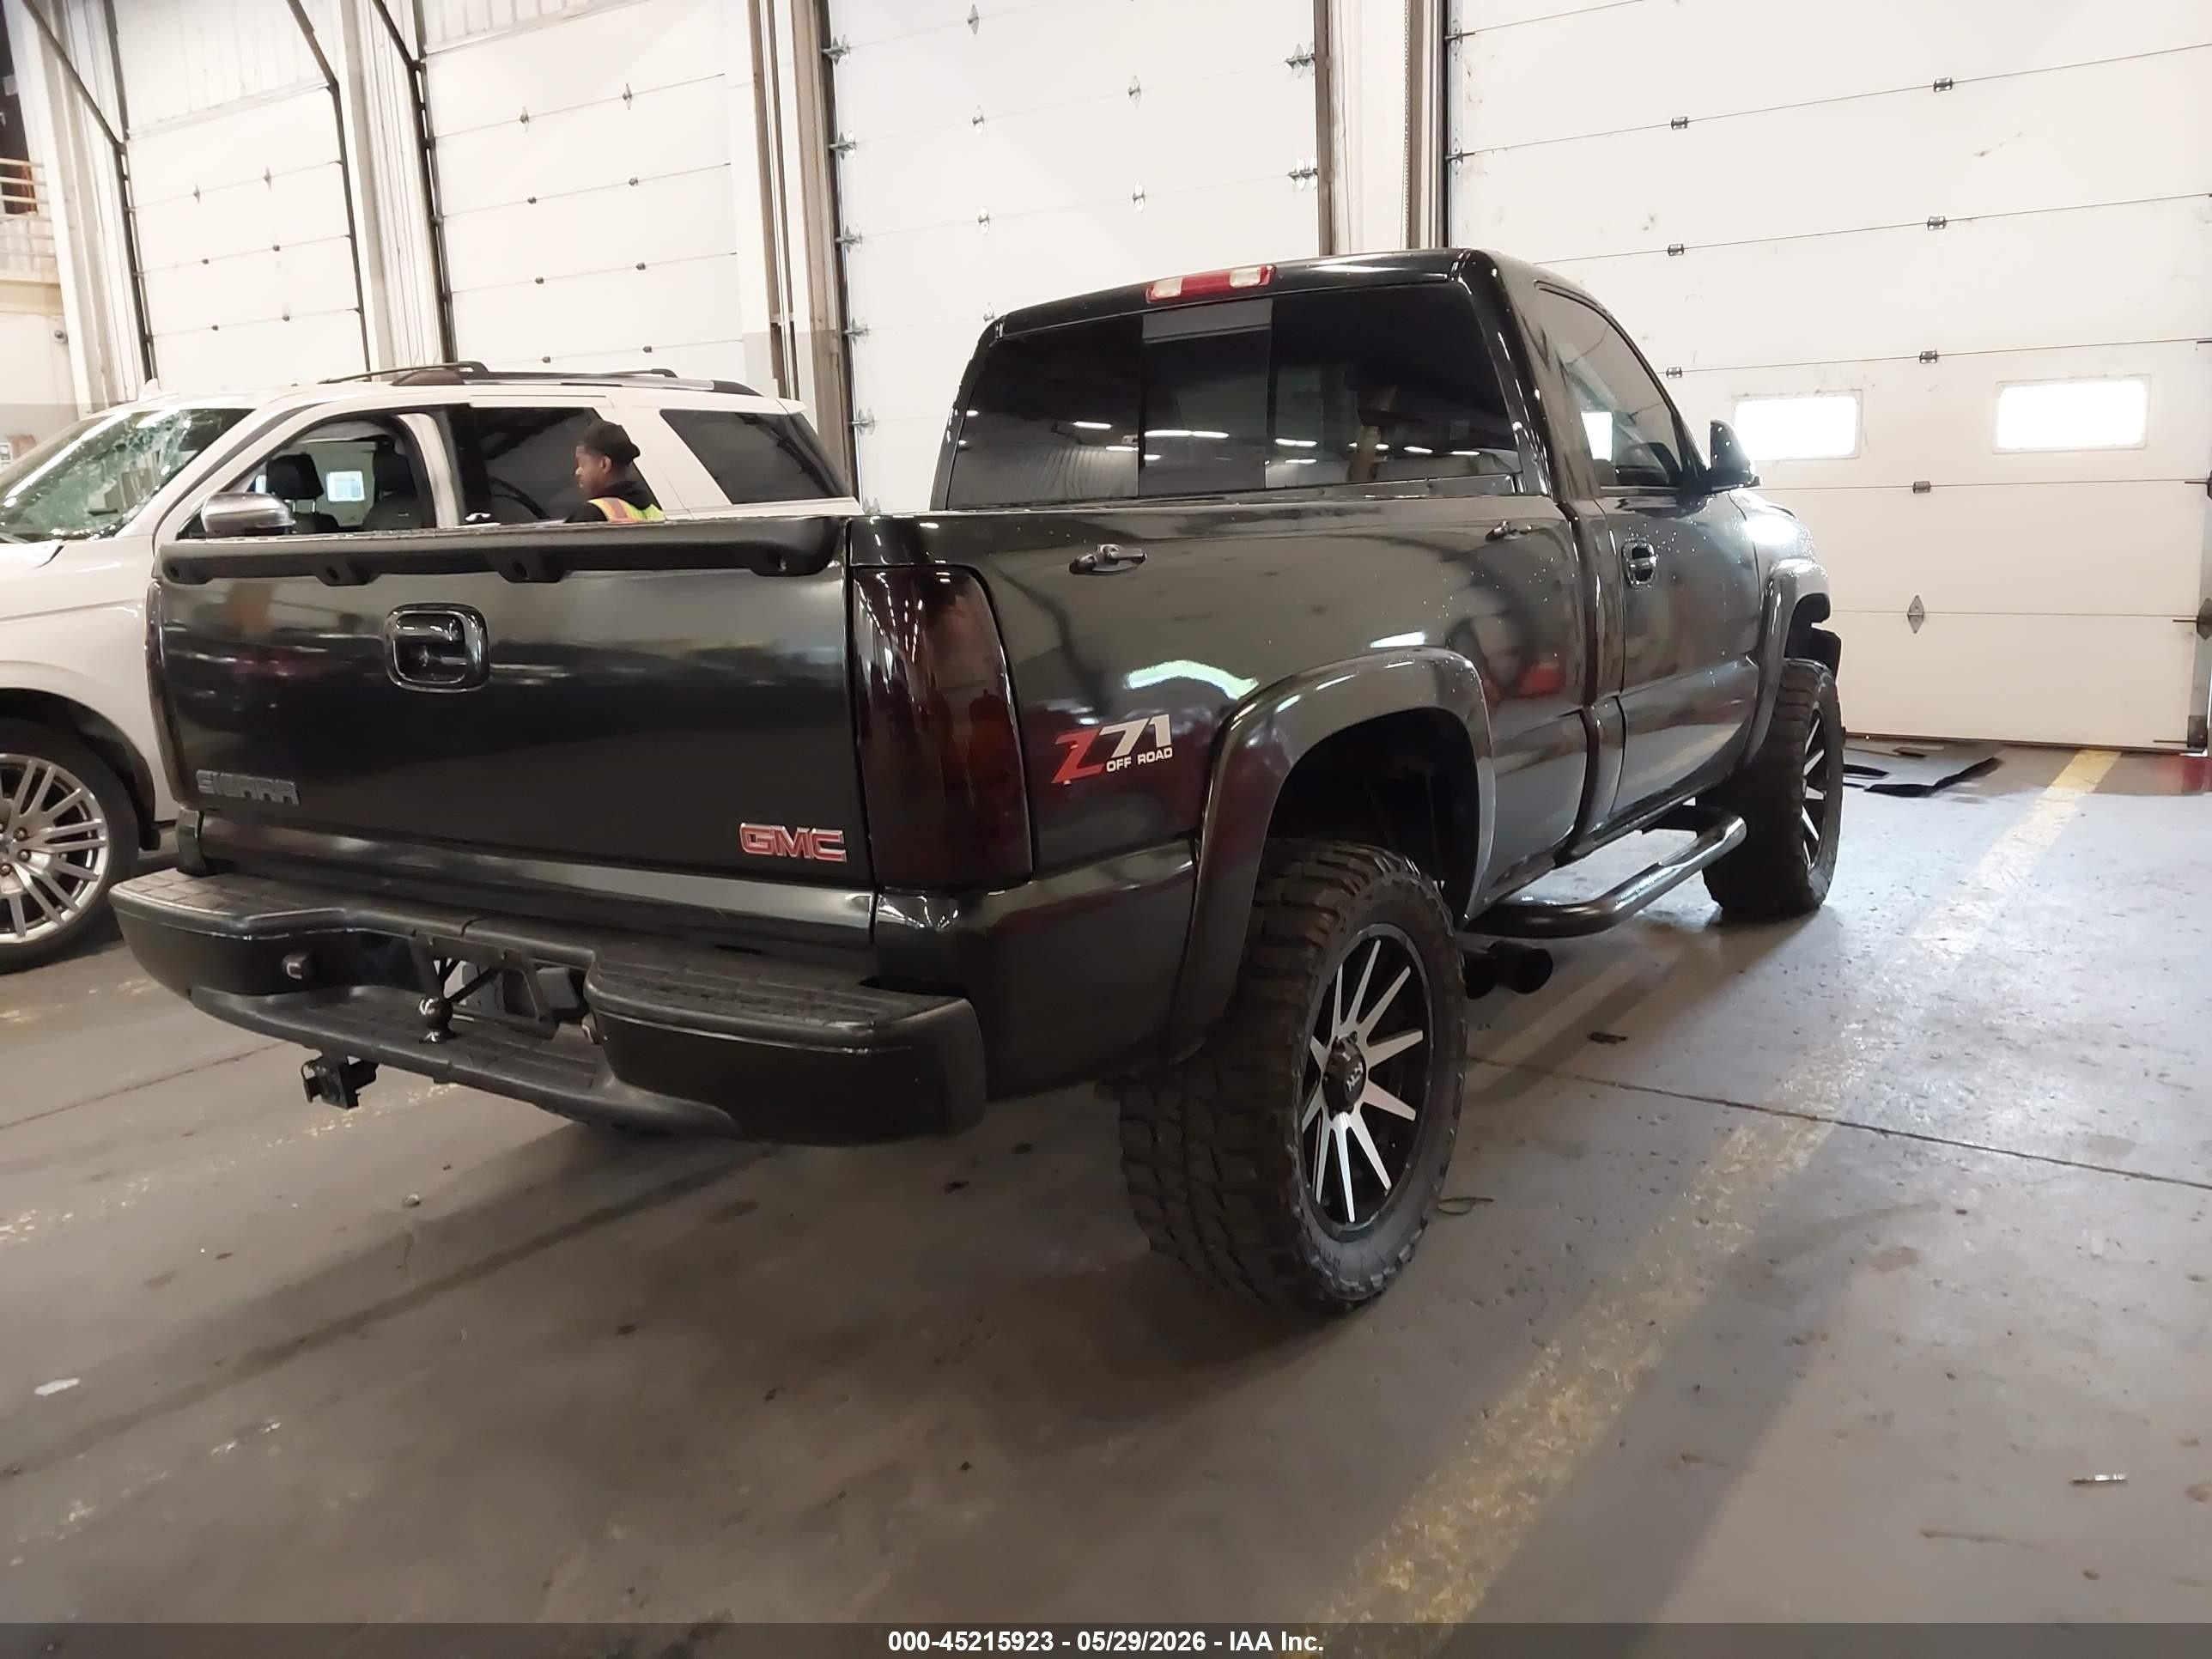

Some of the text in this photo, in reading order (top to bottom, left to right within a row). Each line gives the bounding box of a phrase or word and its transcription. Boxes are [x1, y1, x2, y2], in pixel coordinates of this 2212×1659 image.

[1051, 714, 1172, 785] Z71
[1106, 747, 1173, 773] OFF ROAD
[739, 822, 848, 862] GMC
